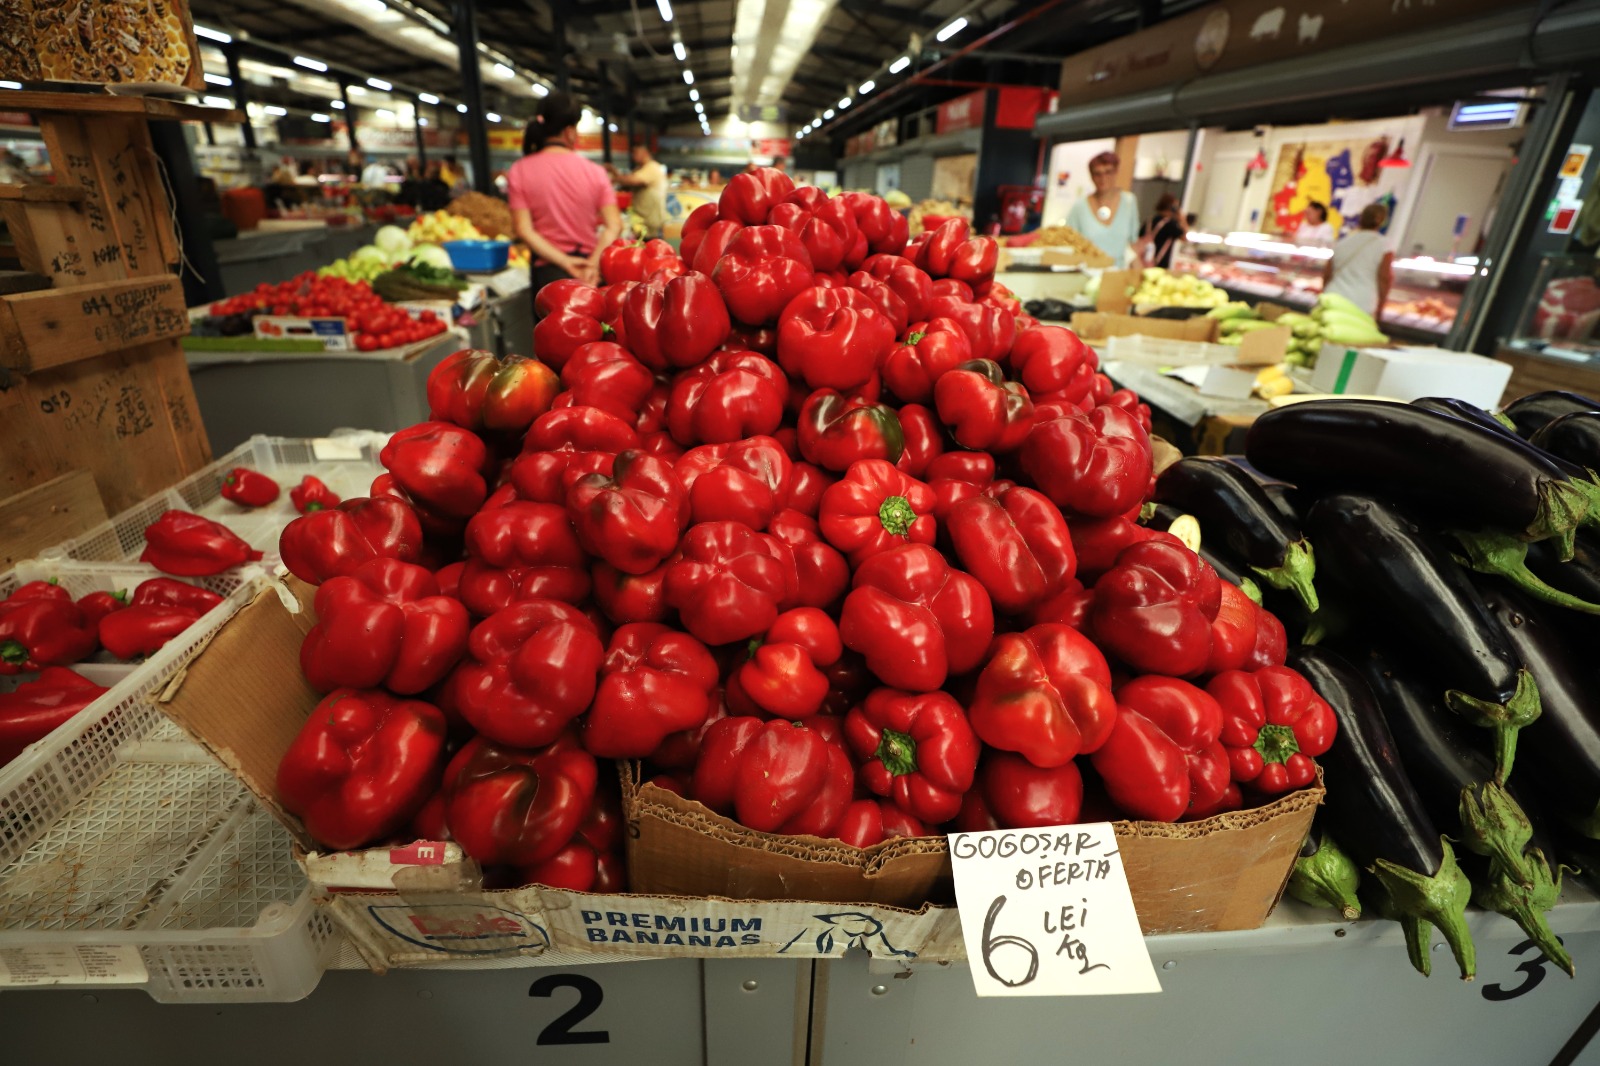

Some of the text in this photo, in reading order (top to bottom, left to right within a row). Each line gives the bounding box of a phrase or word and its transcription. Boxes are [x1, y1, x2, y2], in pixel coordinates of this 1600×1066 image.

[581, 910, 762, 932] PREMIUM
[586, 928, 760, 947] BANANAS
[981, 895, 1039, 987] 6
[1482, 935, 1564, 1001] 3
[528, 973, 610, 1046] 2
